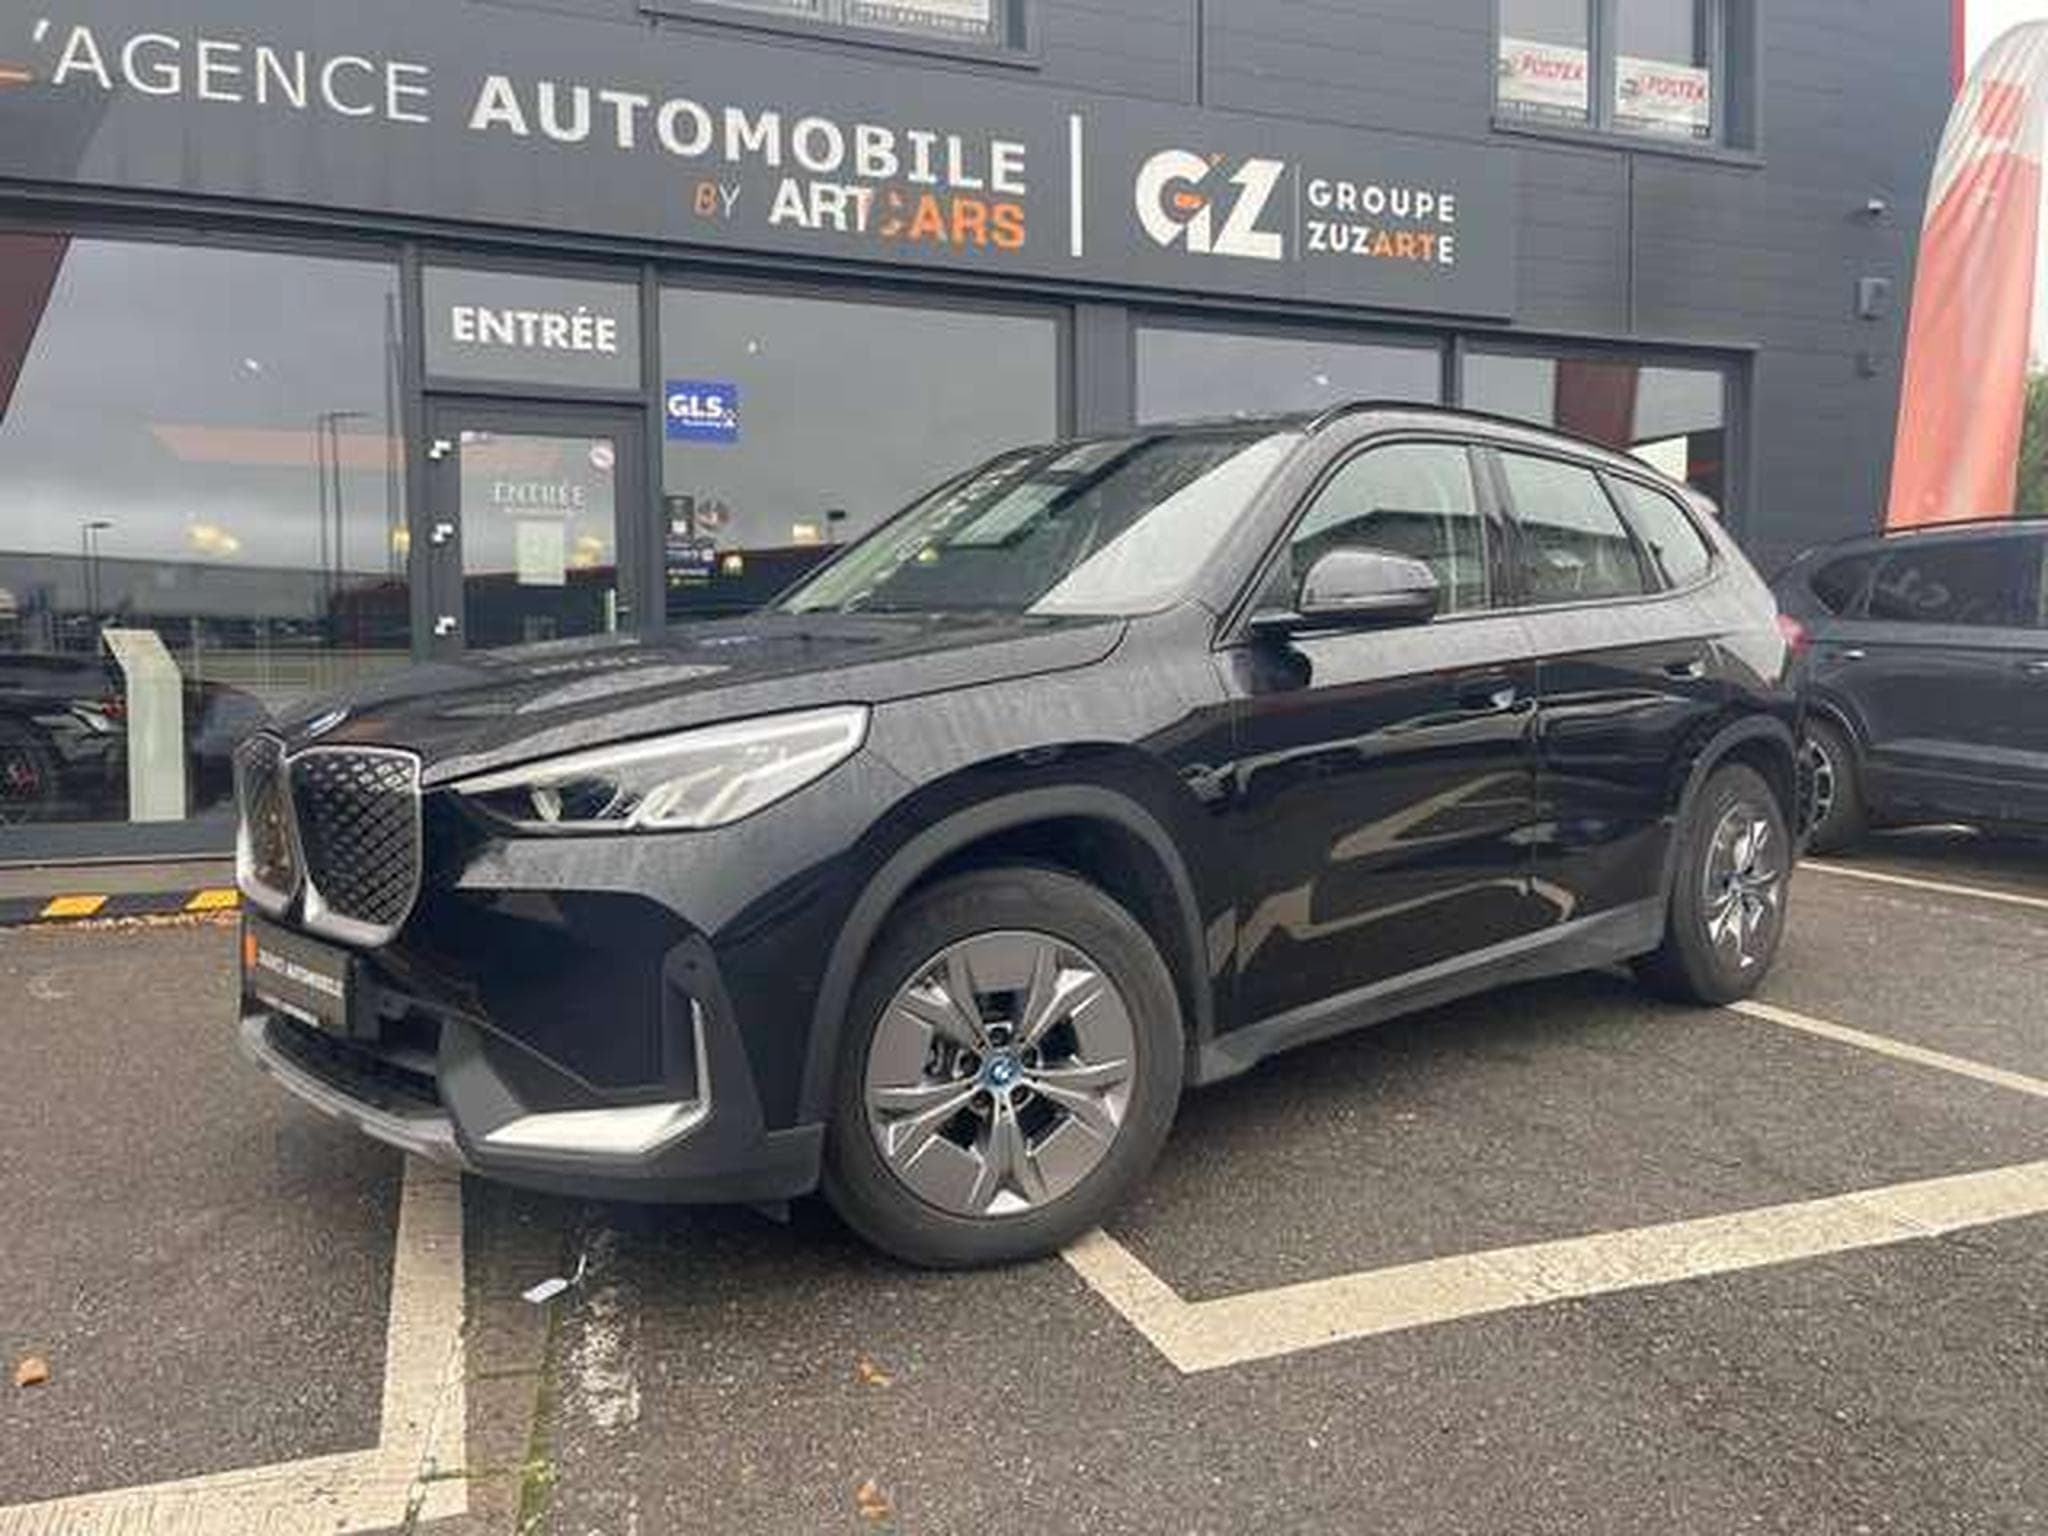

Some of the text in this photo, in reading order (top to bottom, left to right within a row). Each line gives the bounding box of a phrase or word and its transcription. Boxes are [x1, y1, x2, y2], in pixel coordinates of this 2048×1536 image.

[468, 74, 1026, 194] AUTOMOBILE
[693, 181, 741, 219] BY
[1308, 179, 1455, 222] GROUPE
[1307, 221, 1455, 264] ZUZARTE
[451, 306, 617, 352] ENTRÉE
[668, 394, 723, 417] GLS
